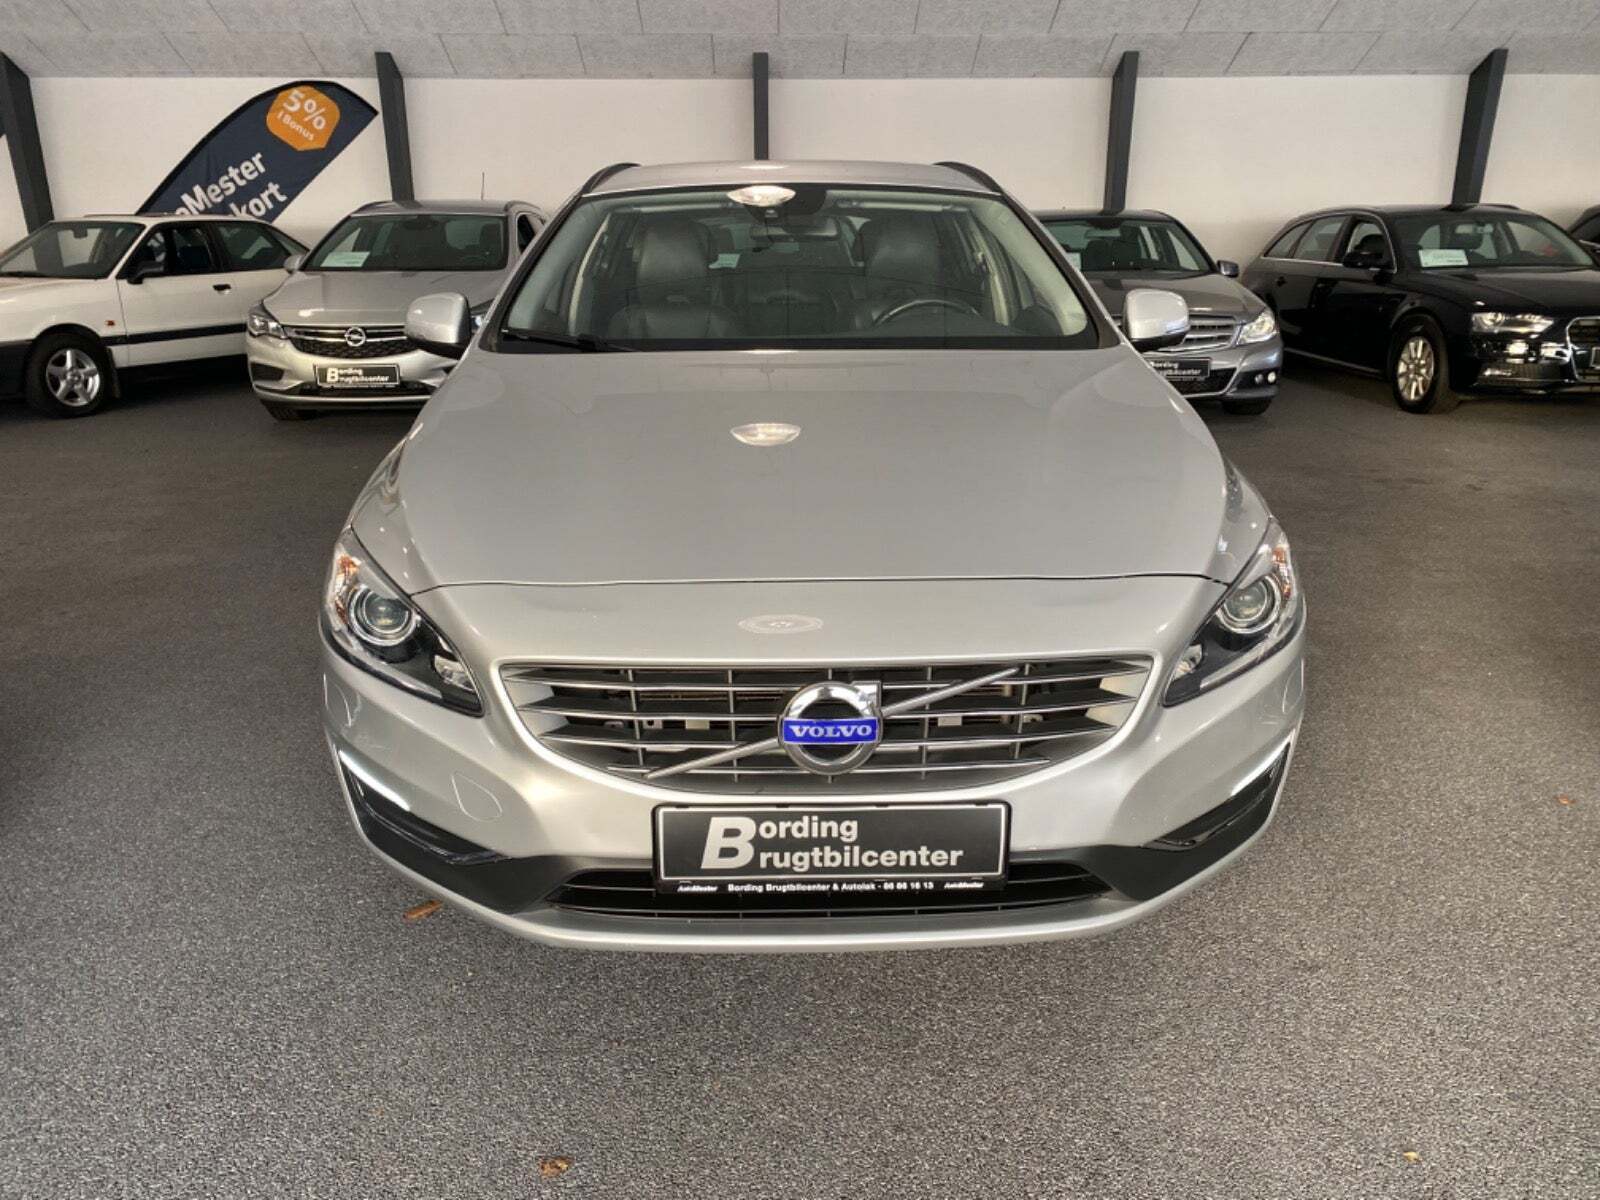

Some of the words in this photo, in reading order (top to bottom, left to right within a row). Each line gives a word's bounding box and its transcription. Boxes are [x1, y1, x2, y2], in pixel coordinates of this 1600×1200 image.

[283, 89, 326, 130] 5%
[282, 114, 315, 141] Bonus
[789, 724, 872, 737] VOLVO
[728, 883, 763, 893] Bording
